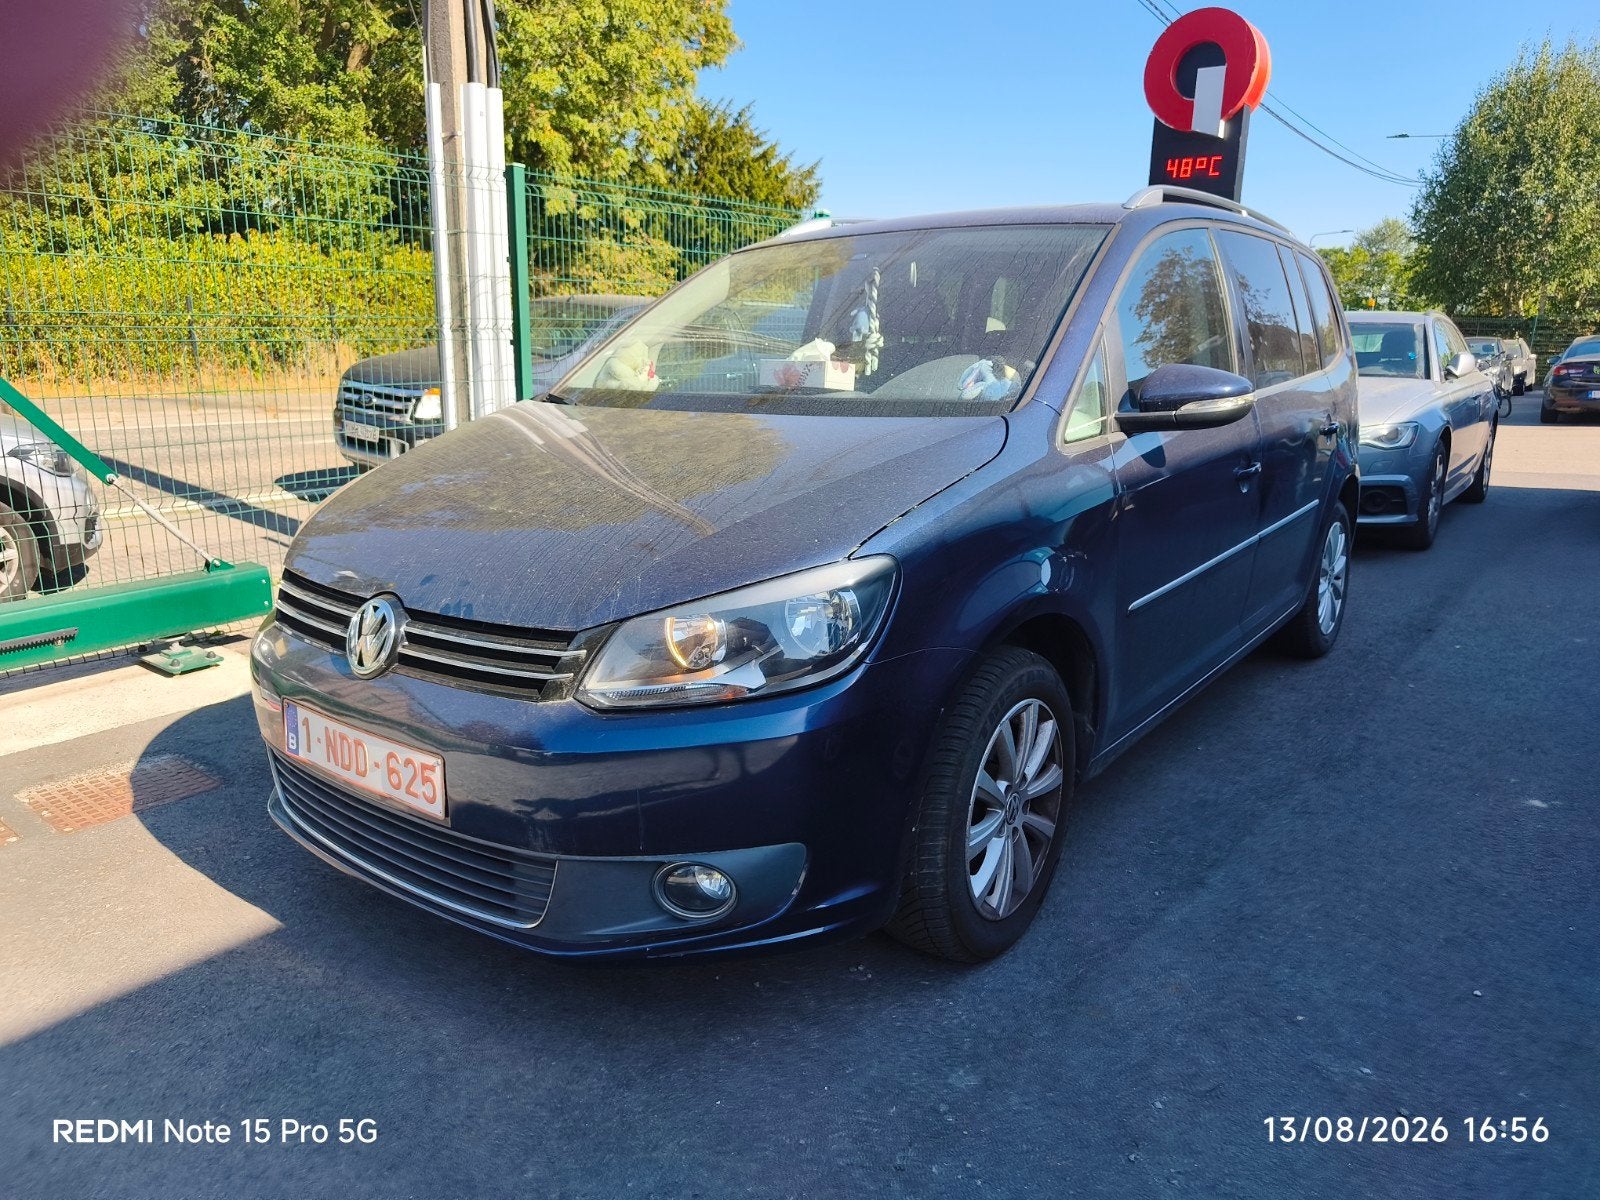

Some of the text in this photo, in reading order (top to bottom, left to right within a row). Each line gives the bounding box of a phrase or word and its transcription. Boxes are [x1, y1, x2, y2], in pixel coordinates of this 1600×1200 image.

[1166, 155, 1223, 178] 48°C
[287, 732, 297, 750] B
[302, 716, 438, 804] 1-NDD-625
